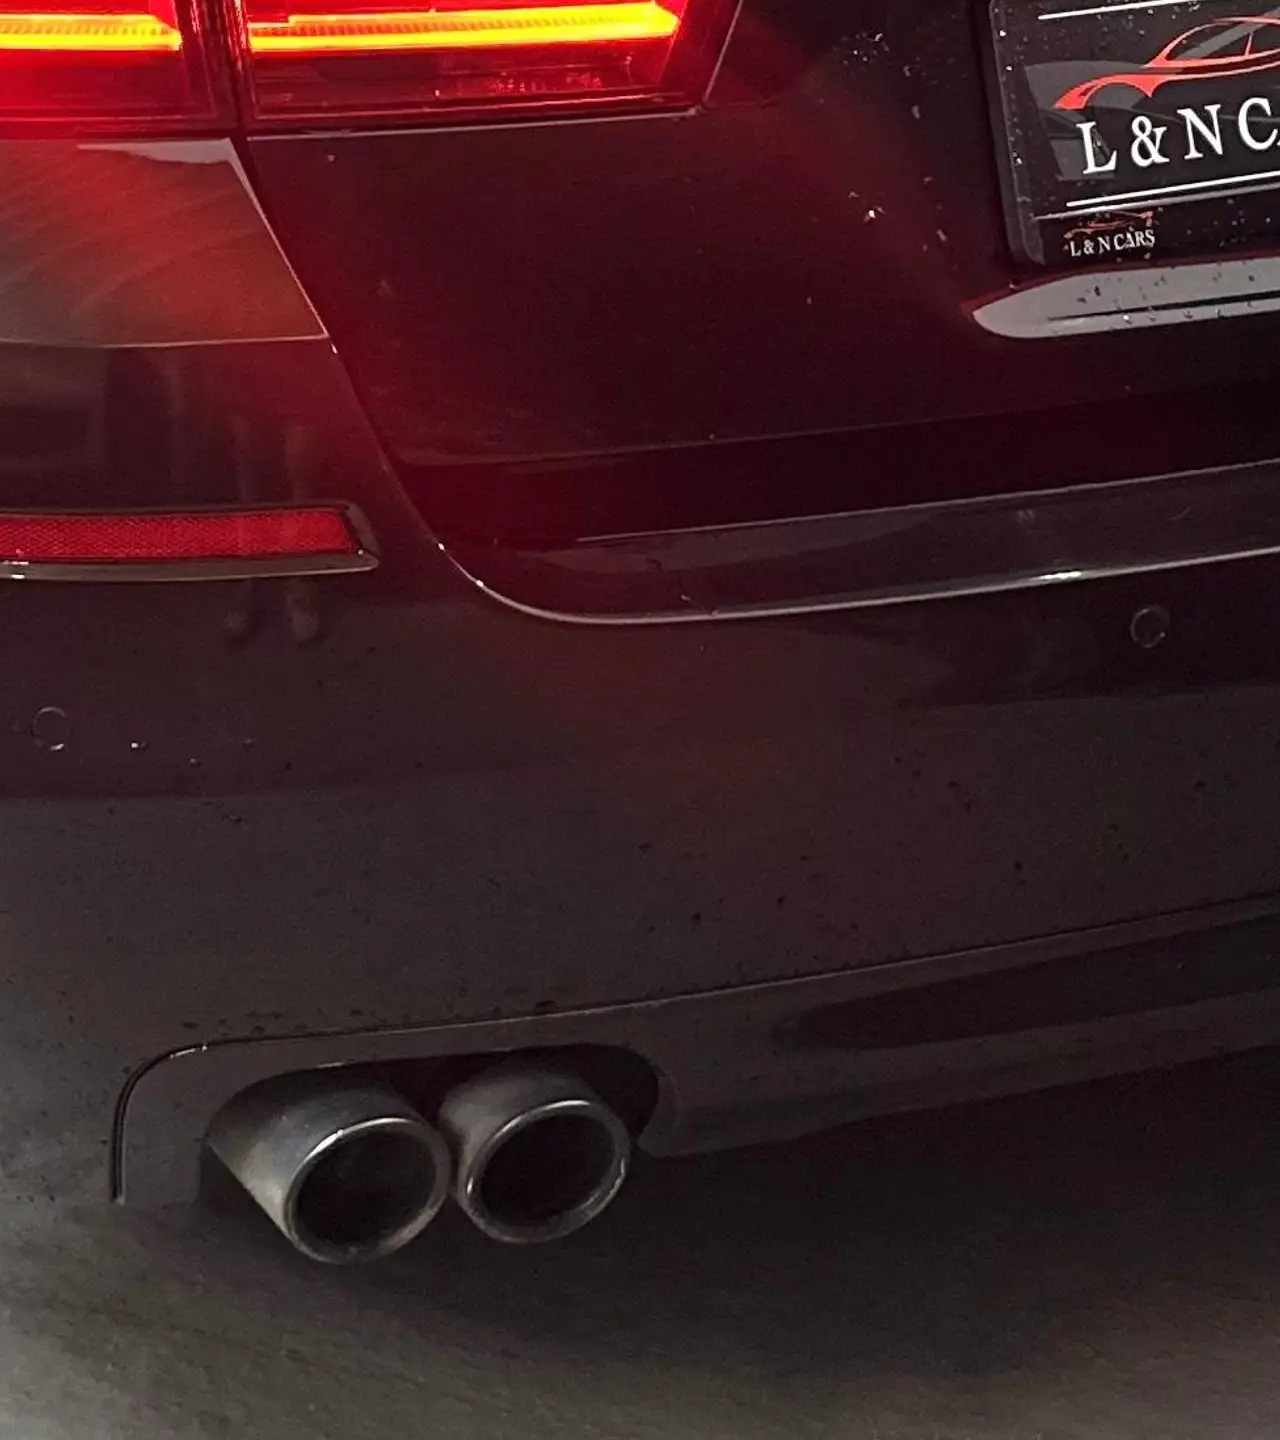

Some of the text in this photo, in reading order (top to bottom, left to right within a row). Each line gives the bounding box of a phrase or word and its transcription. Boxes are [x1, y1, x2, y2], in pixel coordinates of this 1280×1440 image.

[1076, 121, 1117, 175] L
[1130, 115, 1170, 168] &
[1177, 103, 1224, 161] N
[1070, 229, 1156, 257] L & N CARS
